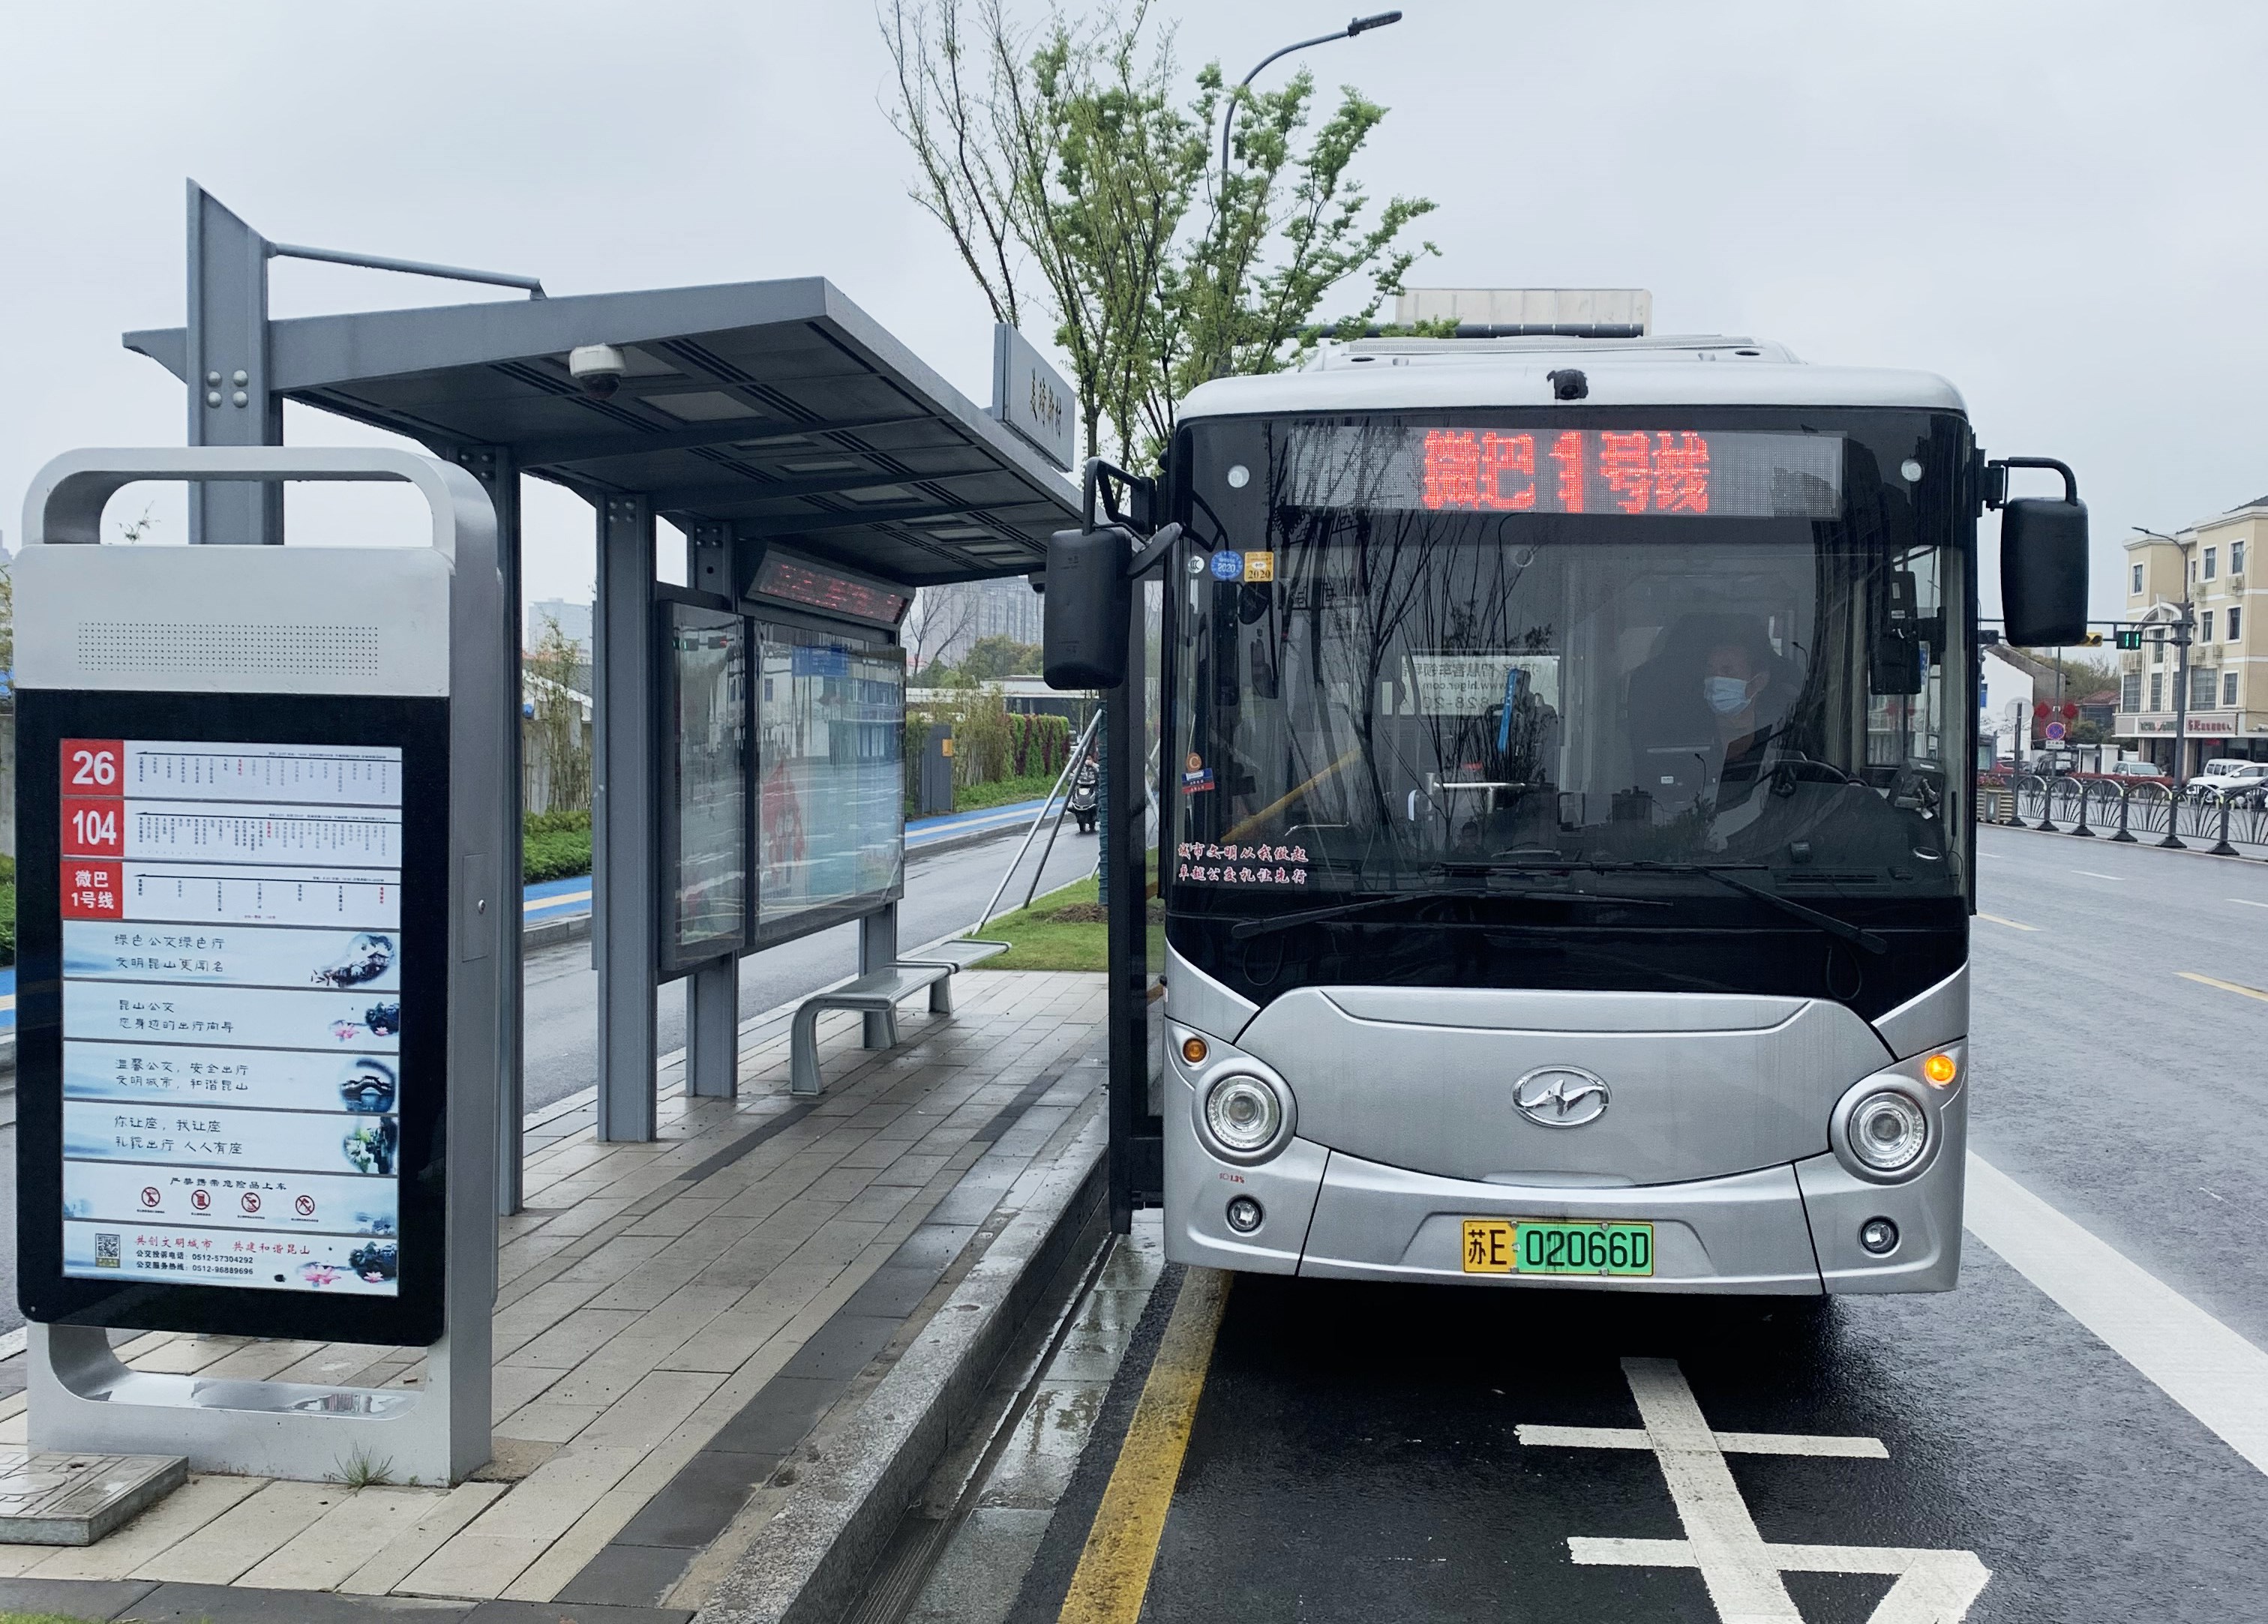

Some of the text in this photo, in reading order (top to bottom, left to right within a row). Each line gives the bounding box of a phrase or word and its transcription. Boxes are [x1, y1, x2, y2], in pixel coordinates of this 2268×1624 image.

[1217, 562, 1236, 572] 2020
[1248, 570, 1271, 580] 2020
[72, 751, 116, 785] 26
[73, 810, 117, 845] 104
[1178, 842, 1309, 862] 城市文明从我做起
[75, 870, 109, 888] 微巴
[1178, 864, 1307, 885] 卓越公交礼让先行
[71, 891, 114, 909] 1号线
[115, 934, 225, 949] 绿色公交绿色行
[116, 957, 224, 972] 文明昆山更闻名
[118, 999, 175, 1012] 昆山公交
[119, 1017, 234, 1033] 您身边的出行向导
[170, 1177, 287, 1191] 严禁携带危险品上车
[135, 1235, 310, 1255] 共创文明城市 共建和谐昆山
[1526, 1230, 1648, 1268] 02066D
